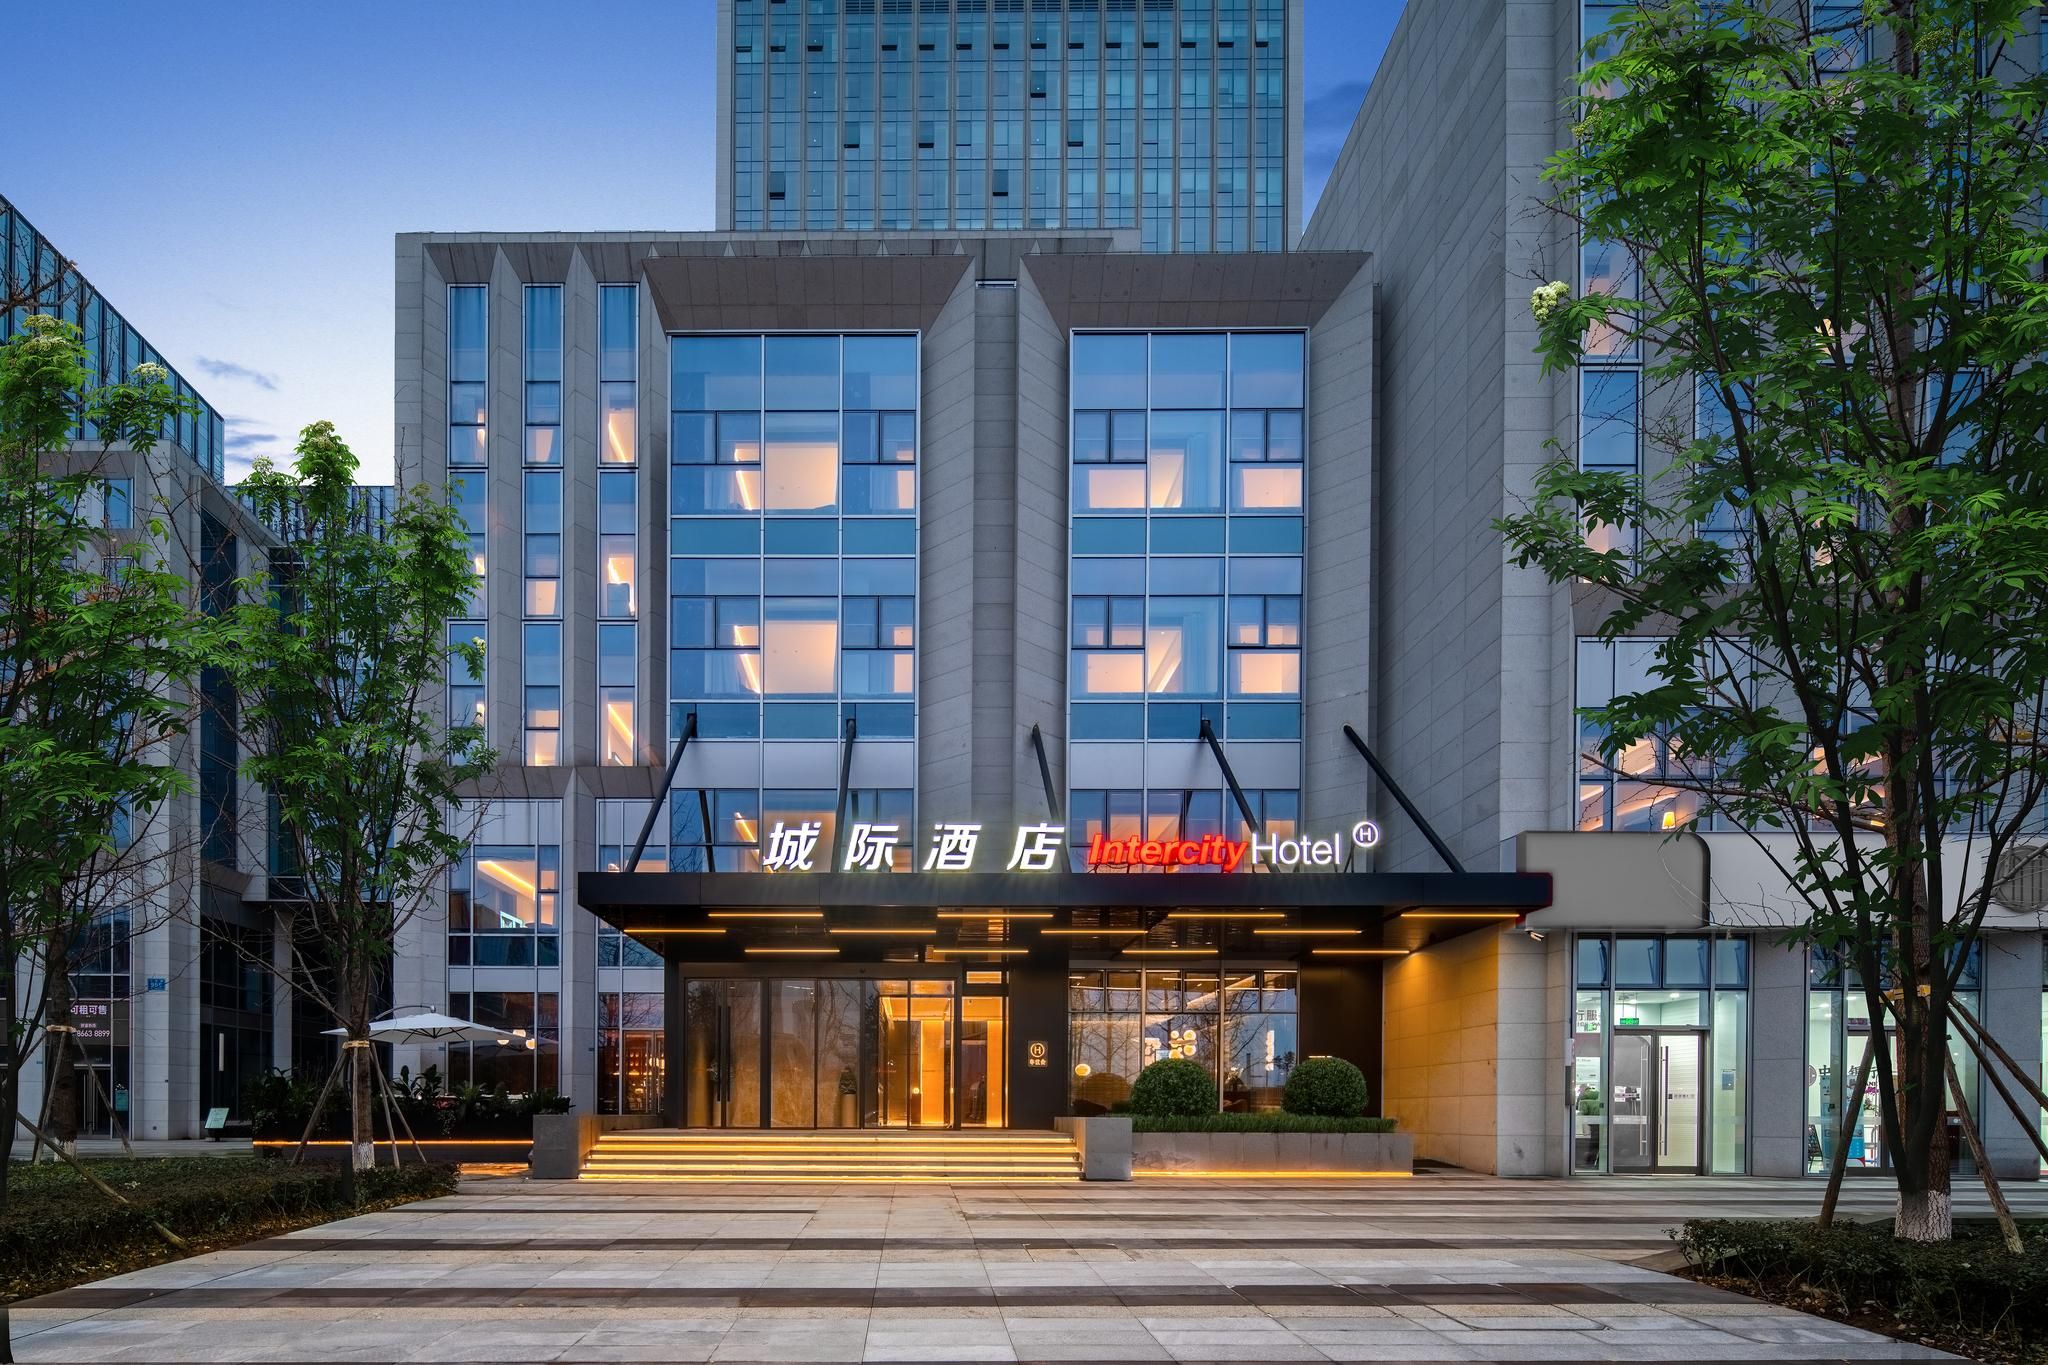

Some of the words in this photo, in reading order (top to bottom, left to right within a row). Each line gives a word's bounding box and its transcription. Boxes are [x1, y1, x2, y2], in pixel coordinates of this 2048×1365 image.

[763, 821, 1065, 871] 城际酒店
[71, 1005, 108, 1015] 可租可售
